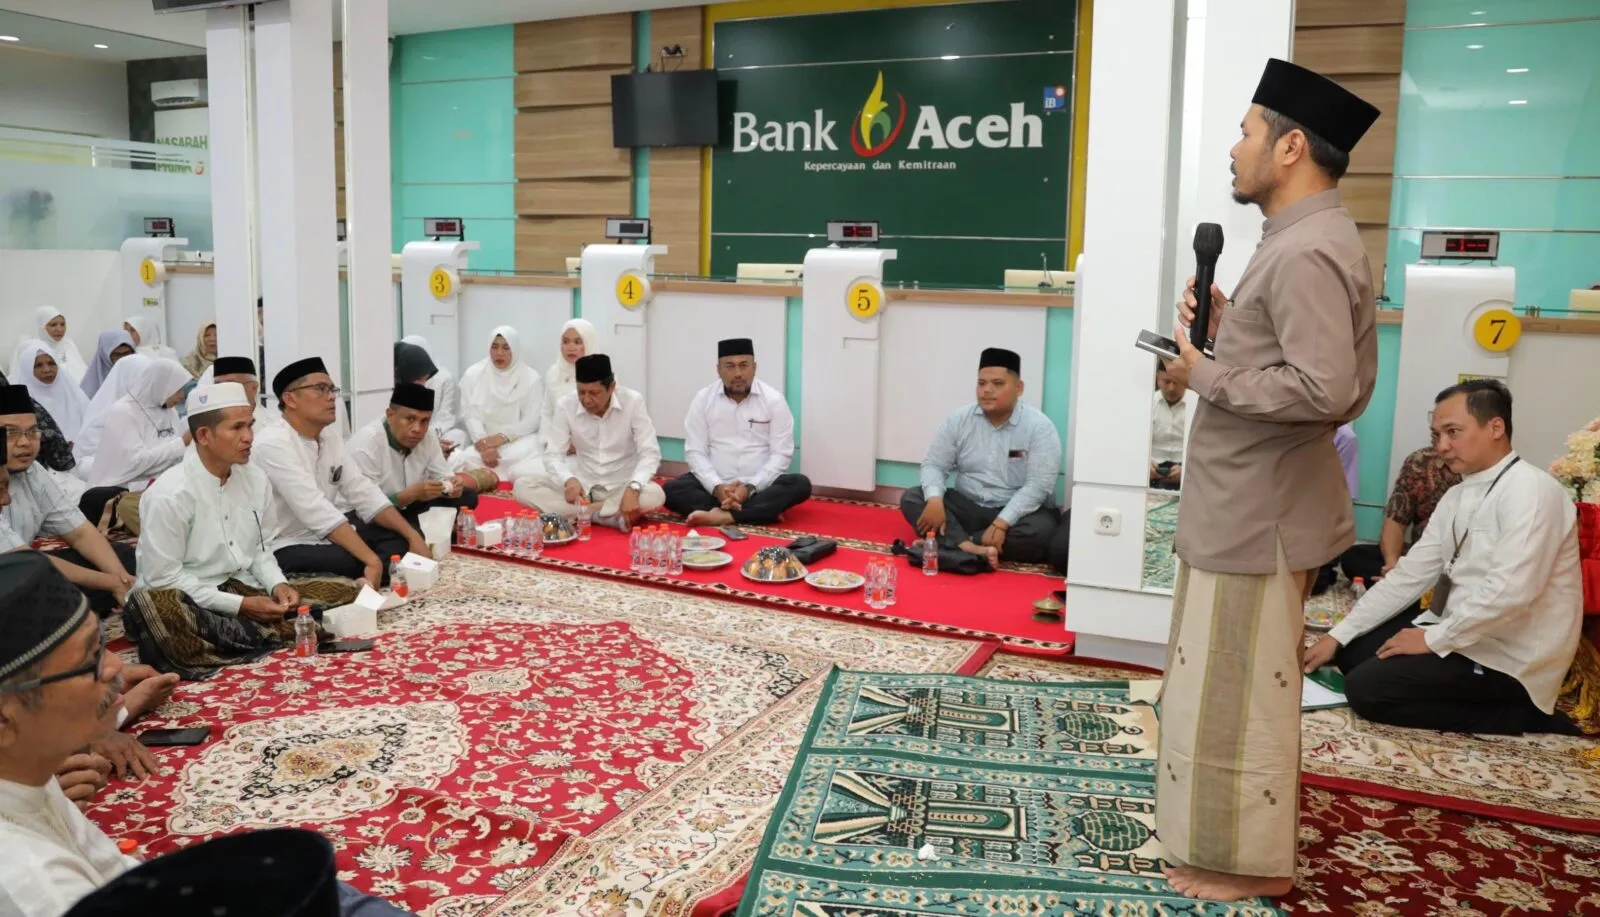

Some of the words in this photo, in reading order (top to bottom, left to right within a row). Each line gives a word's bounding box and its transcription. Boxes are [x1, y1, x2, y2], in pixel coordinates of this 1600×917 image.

[732, 108, 839, 153] Bank
[907, 102, 1043, 149] Aceh
[804, 161, 866, 173] Kepercayaan
[872, 160, 892, 171] dan
[898, 160, 957, 170] Kemitraan
[144, 264, 152, 280] 1
[435, 274, 445, 293] 3
[623, 280, 634, 299] 4
[857, 289, 871, 311] 5
[1490, 319, 1507, 344] 7
